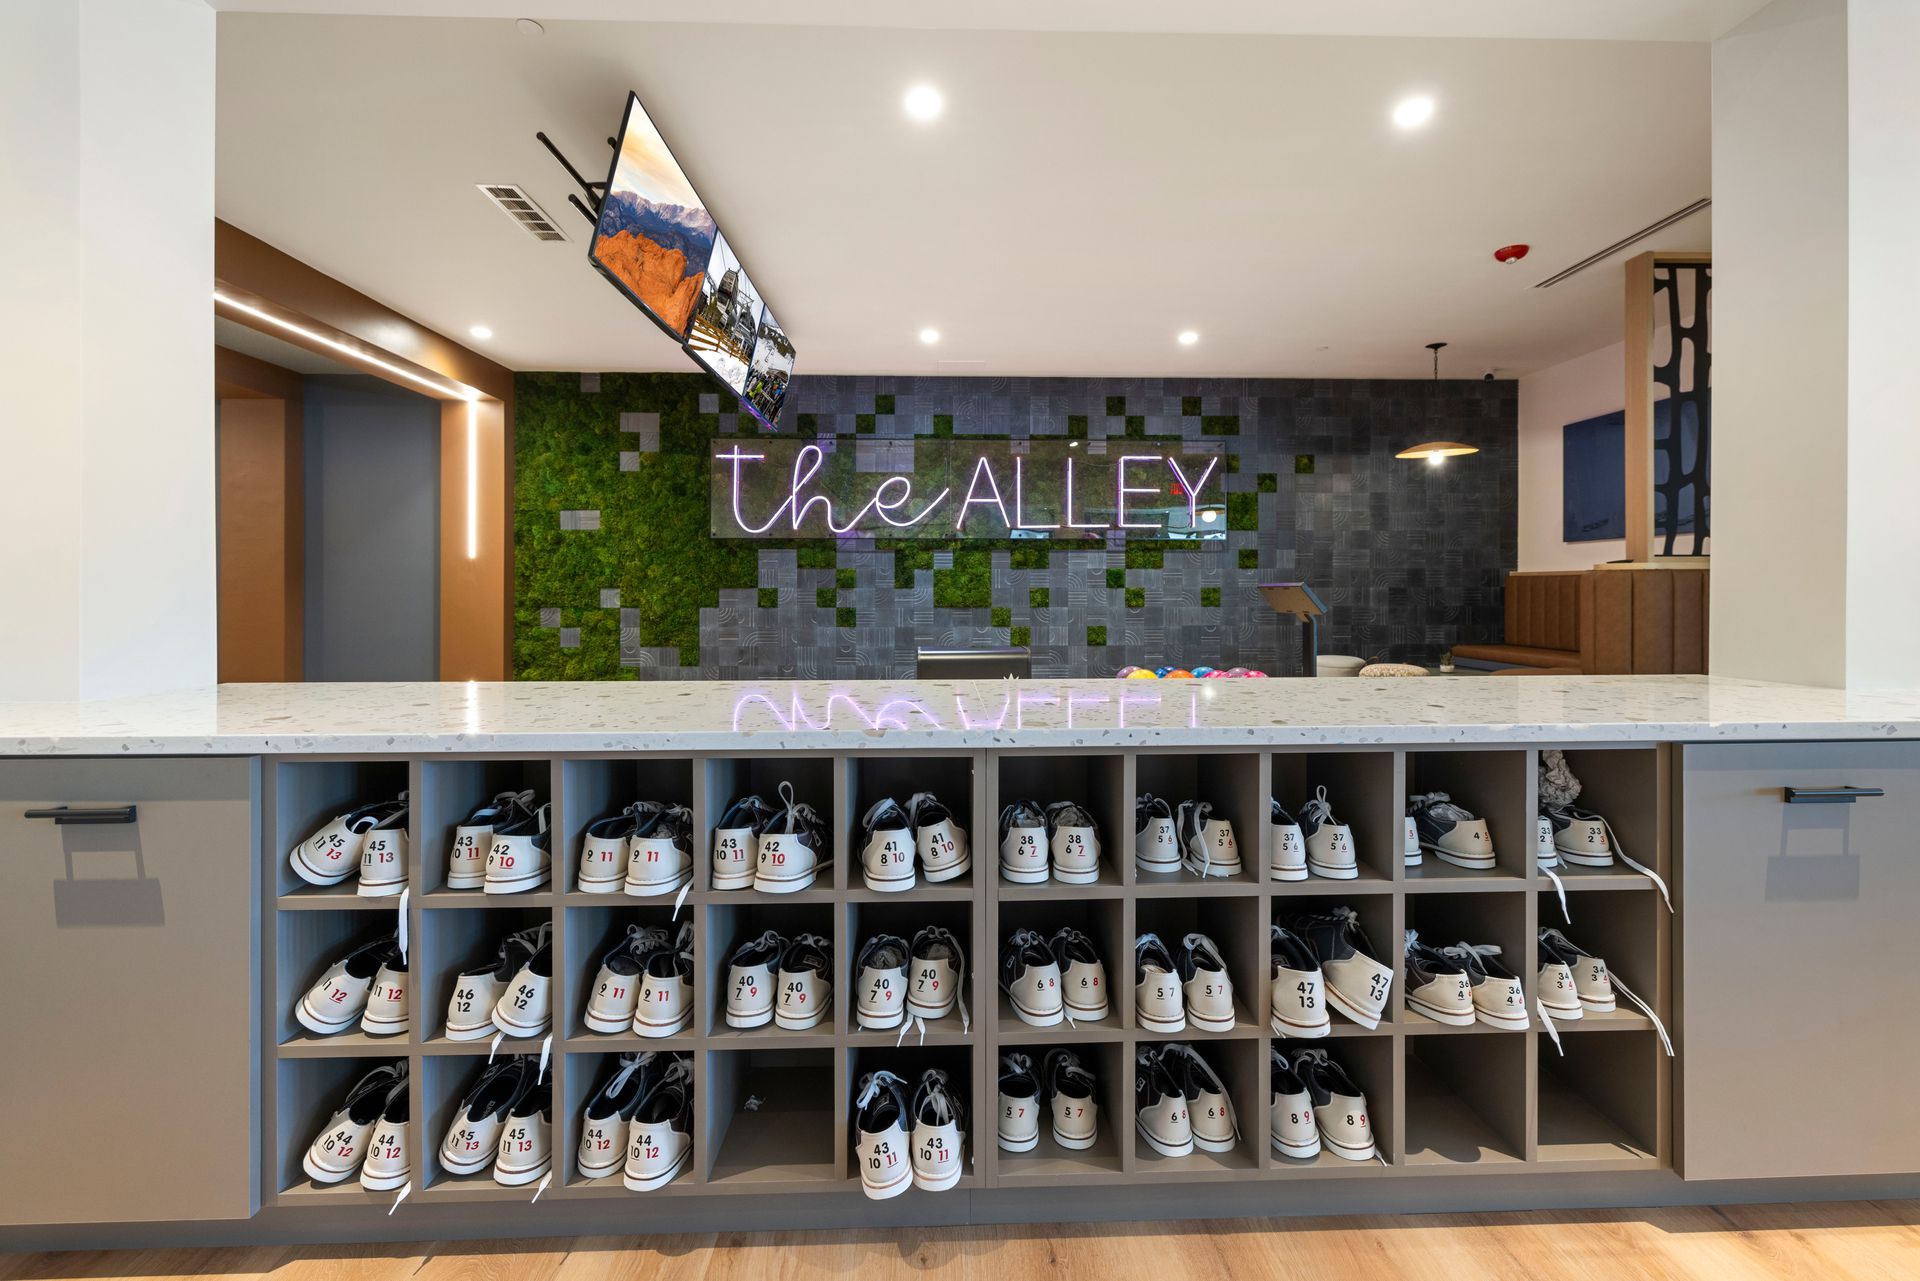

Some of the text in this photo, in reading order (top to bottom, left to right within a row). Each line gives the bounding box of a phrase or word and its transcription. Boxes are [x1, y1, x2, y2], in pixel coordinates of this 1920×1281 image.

[715, 445, 1218, 533] the ALLEY
[329, 834, 345, 847] 45
[457, 836, 473, 846] 43
[721, 839, 736, 848] 43
[932, 833, 944, 844] 41
[1021, 836, 1033, 844] 38
[1069, 835, 1081, 843] 38
[315, 836, 342, 860] 11 13
[369, 841, 386, 851] 45
[493, 845, 509, 855] 42
[765, 842, 779, 851] 42
[885, 842, 897, 852] 41
[931, 841, 954, 856] 8 10
[1018, 846, 1037, 855] 6 7
[1066, 845, 1084, 854] 6 7
[365, 852, 394, 864] 11 13
[468, 848, 479, 857] 11
[587, 850, 612, 862] 9 11
[634, 850, 658, 862] 9 11
[716, 849, 744, 860] 10 11
[881, 852, 905, 864] 8 10
[489, 856, 514, 867] 9 10
[761, 854, 785, 864] 9 10
[921, 969, 936, 979] 40
[739, 976, 754, 986] 40
[874, 979, 889, 989] 40
[918, 980, 938, 990] 7 9
[1038, 978, 1054, 988] 6 8
[1082, 977, 1098, 986] 6 8
[1372, 973, 1388, 988] 47
[374, 985, 402, 999] 11 12
[518, 985, 535, 998] 46
[600, 984, 625, 999] 9 11
[736, 987, 757, 998] 7 9
[788, 982, 803, 992] 40
[1158, 988, 1174, 997] 5 7
[1206, 985, 1223, 994] 5 7
[1297, 982, 1315, 994] 47
[331, 989, 347, 1002] 12
[457, 989, 474, 1000] 46
[645, 989, 669, 1002] 9 11
[784, 994, 806, 1003] 7 9
[870, 990, 892, 1000] 7 9
[1370, 985, 1383, 1001] 13
[457, 1002, 470, 1012] 12
[514, 996, 527, 1010] 12
[1299, 996, 1314, 1008] 13
[1007, 1107, 1024, 1117] 5 7
[1065, 1107, 1083, 1117] 5 7
[1172, 1110, 1186, 1121] 6 8
[1209, 1107, 1224, 1116] 6 8
[1291, 1111, 1310, 1123] 8 9
[1347, 1115, 1365, 1125] 8 9
[337, 1131, 352, 1145] 44
[459, 1130, 475, 1140] 45
[509, 1129, 525, 1139] 45
[588, 1130, 602, 1139] 44
[324, 1135, 353, 1157] 10 12
[379, 1135, 394, 1146] 44
[452, 1134, 479, 1150] 11 13
[598, 1140, 610, 1150] 12
[637, 1135, 652, 1146] 44
[927, 1138, 943, 1148] 43
[371, 1144, 401, 1159] 10 12
[503, 1141, 532, 1152] 11 13
[631, 1146, 659, 1158] 10 12
[874, 1142, 889, 1155] 43
[869, 1152, 897, 1168] 10 11
[920, 1148, 949, 1161] 10 11
